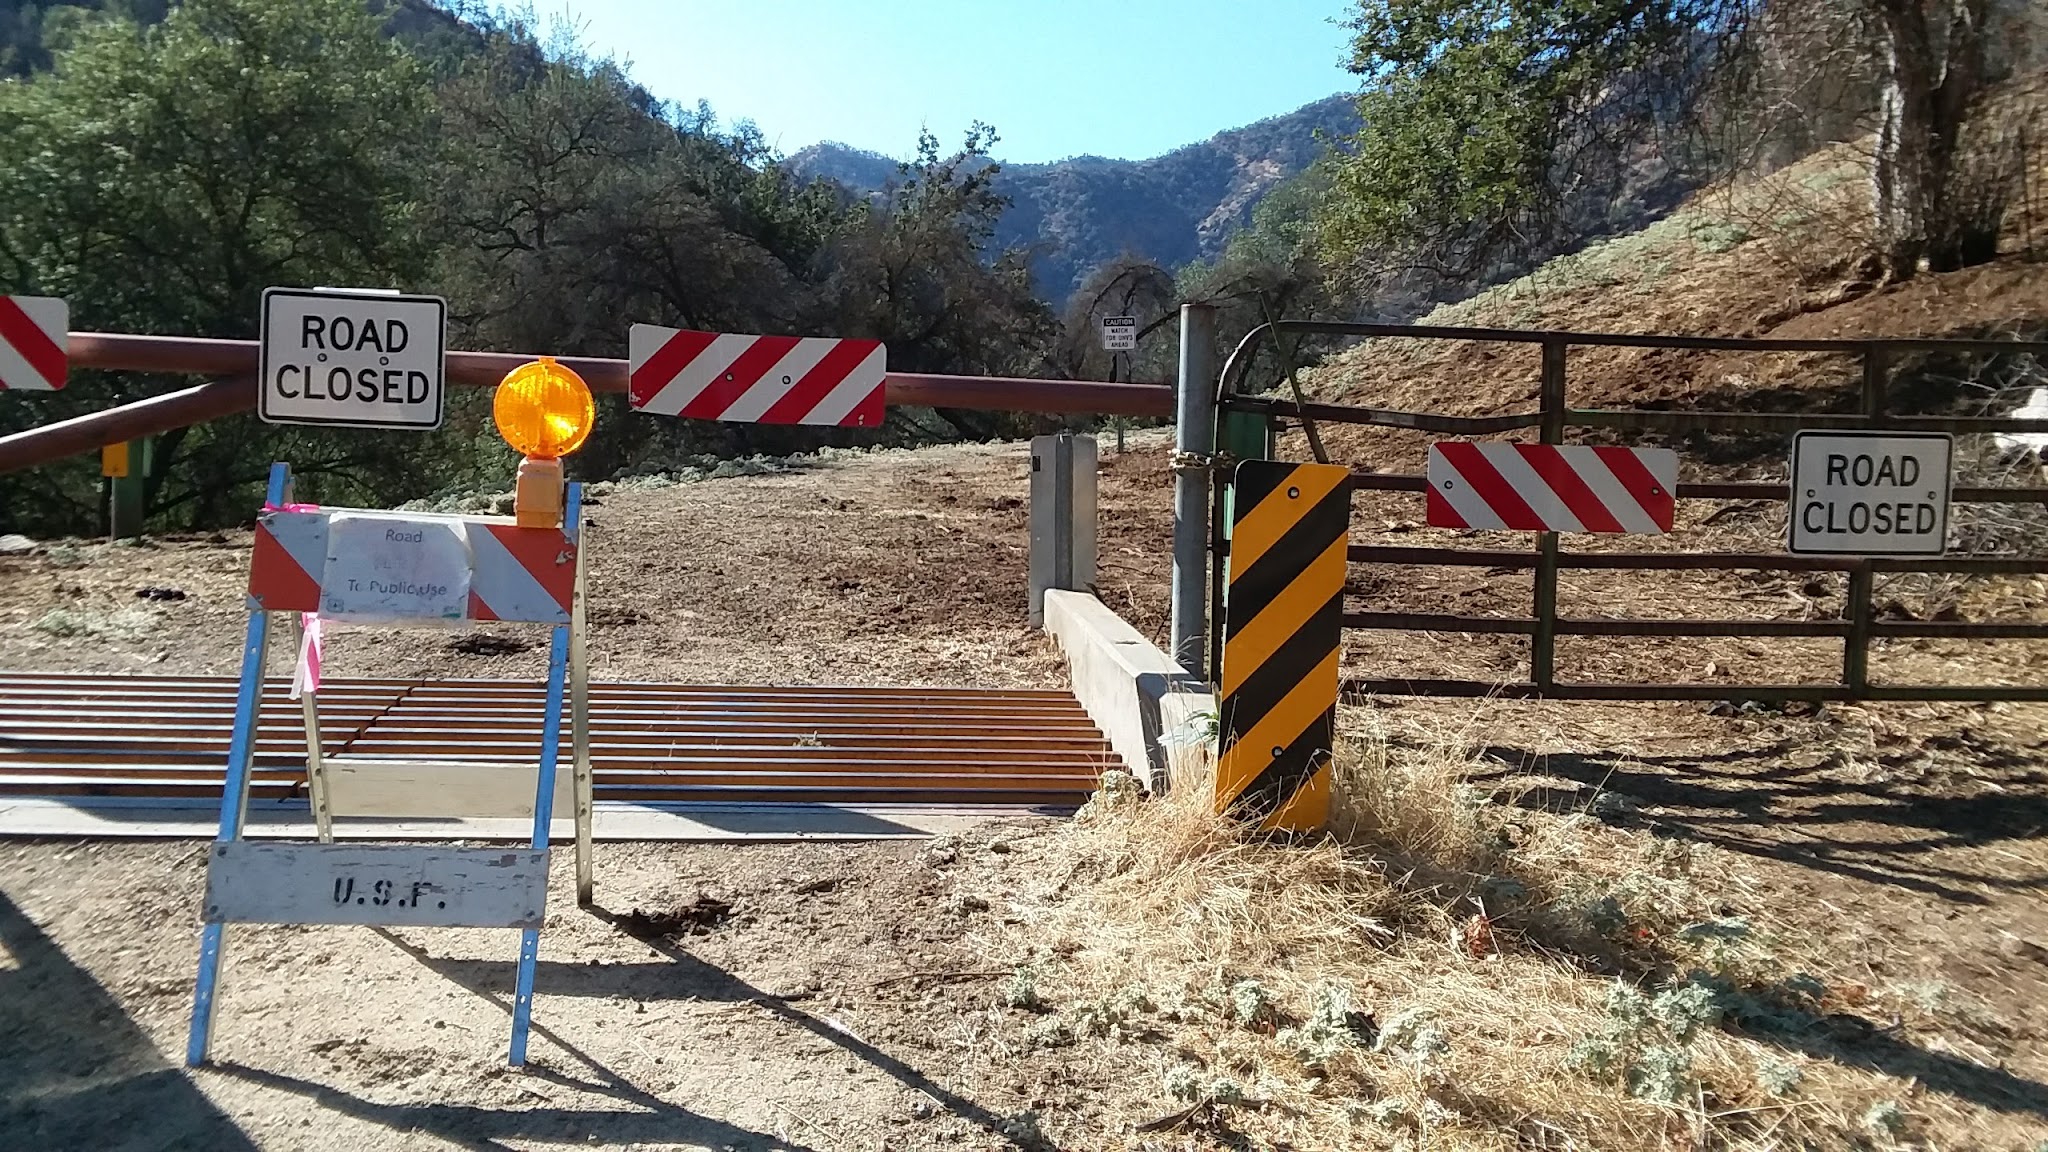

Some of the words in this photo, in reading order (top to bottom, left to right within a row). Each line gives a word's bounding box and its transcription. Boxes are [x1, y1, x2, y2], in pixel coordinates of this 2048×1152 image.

[302, 315, 409, 353] ROAD
[276, 364, 430, 404] CLOSED
[1826, 454, 1920, 487] ROAD
[1803, 501, 1936, 534] CLOSED
[385, 528, 423, 543] Road
[369, 580, 415, 596] Public
[419, 582, 448, 596] Use
[333, 877, 446, 908] U.S.F.
